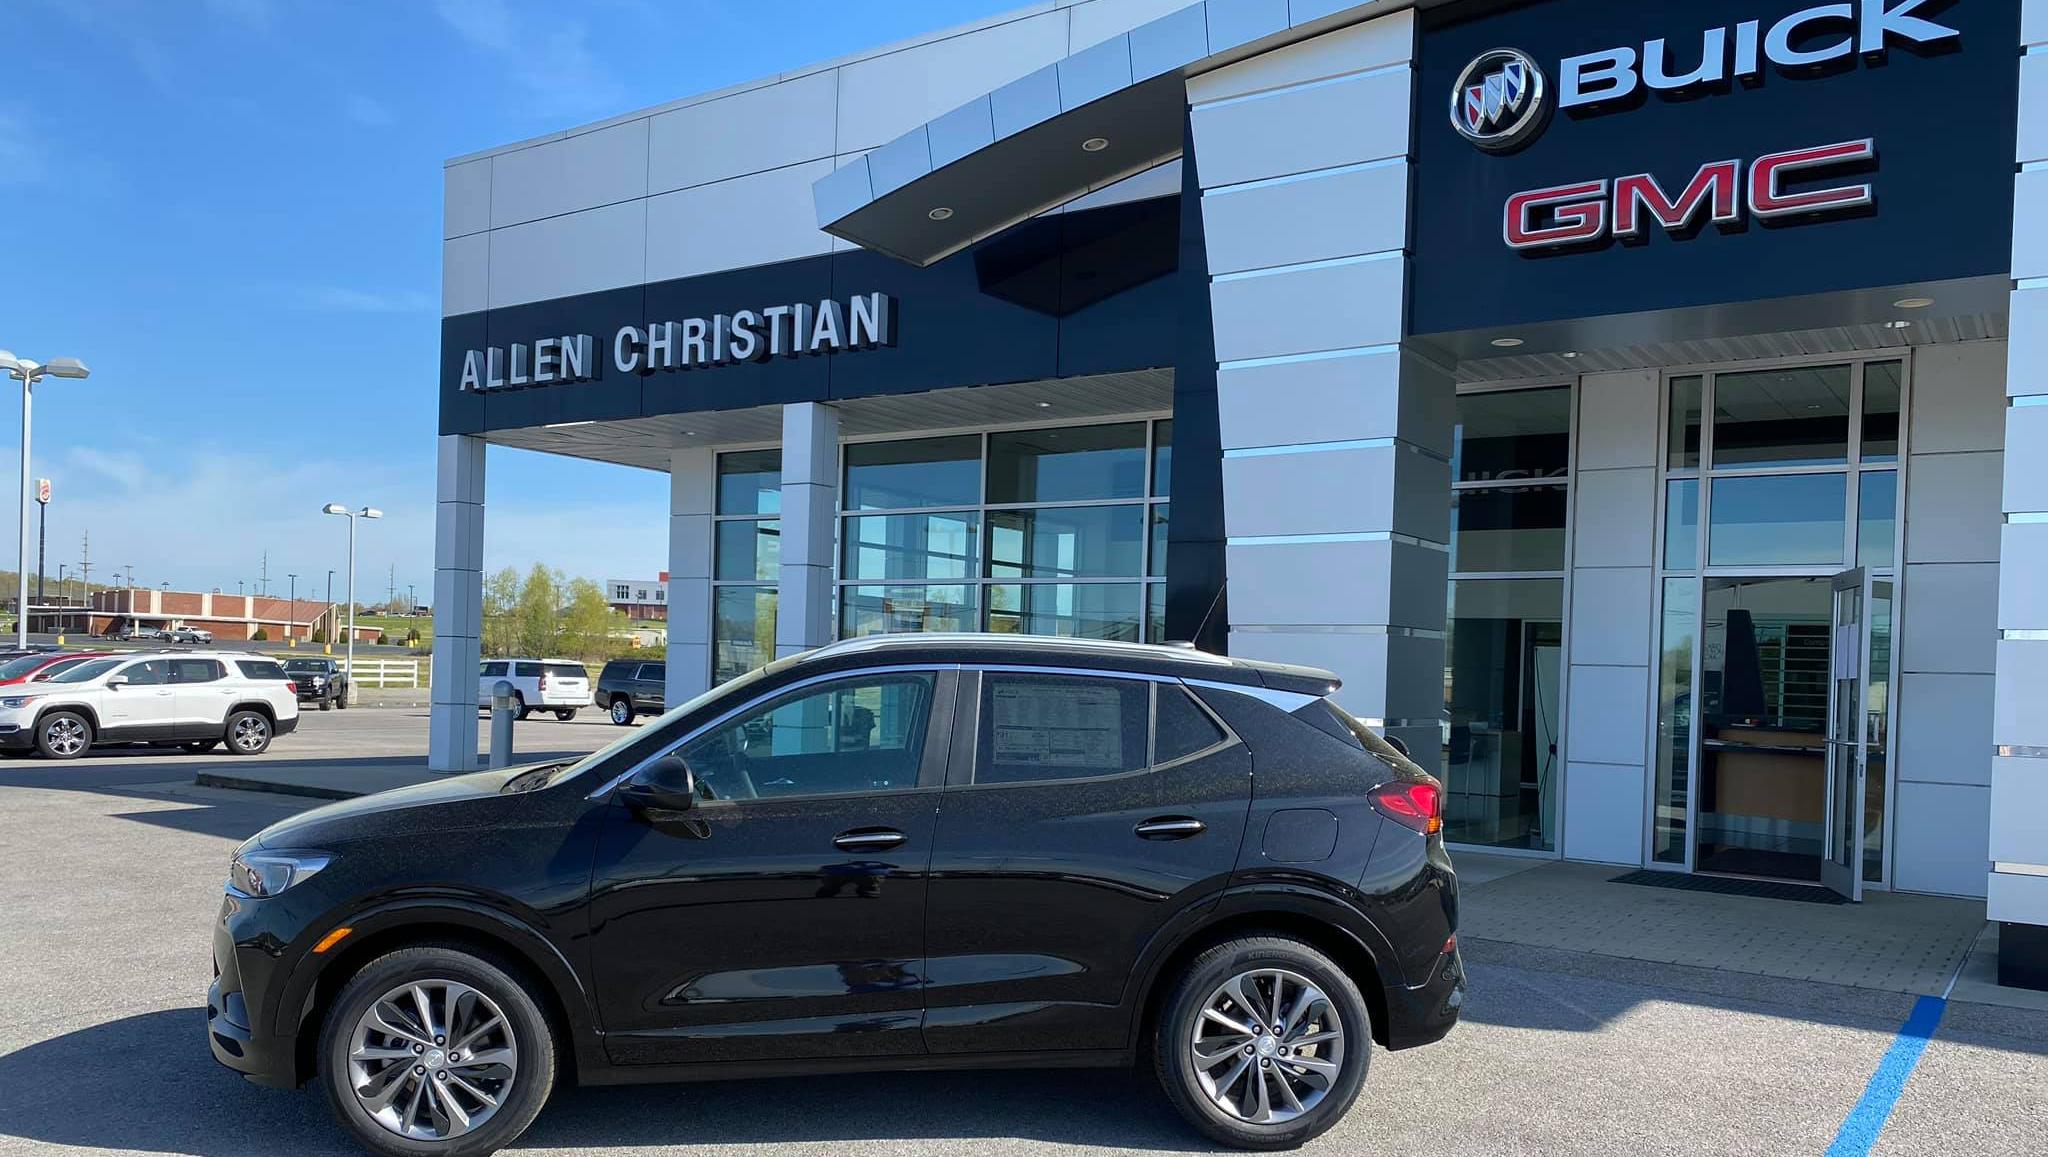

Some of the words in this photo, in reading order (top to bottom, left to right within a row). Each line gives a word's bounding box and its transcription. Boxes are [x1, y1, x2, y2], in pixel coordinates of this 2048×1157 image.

[1558, 0, 1961, 108] BUICK
[1502, 137, 1876, 250] GMC
[459, 333, 593, 391] ALLEN
[613, 291, 890, 373] CHRISTIAN
